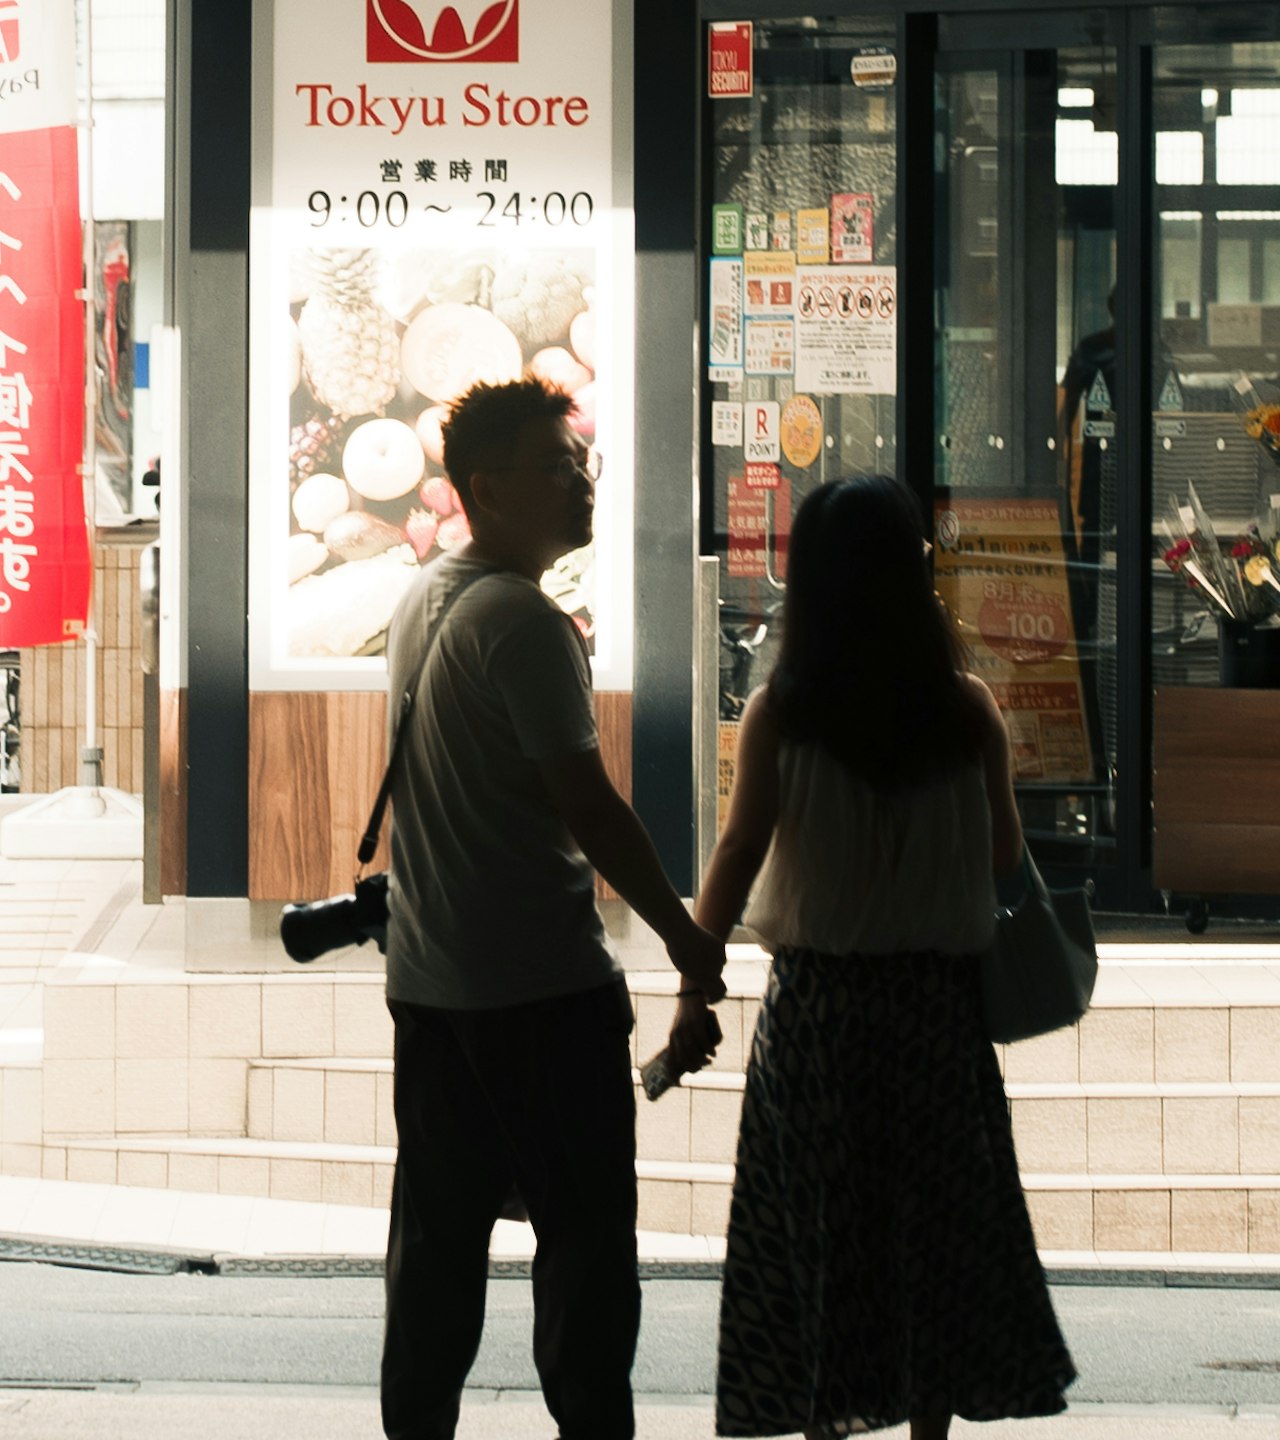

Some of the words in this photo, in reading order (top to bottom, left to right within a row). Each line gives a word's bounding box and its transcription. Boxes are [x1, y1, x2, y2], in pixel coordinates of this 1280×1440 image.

[711, 71, 749, 91] SECURITY
[295, 83, 448, 136] Tokyu
[462, 83, 590, 127] Store
[379, 158, 508, 183] 営業時間
[307, 190, 409, 228] 9:00
[476, 191, 594, 227] 24:00
[756, 408, 768, 435] R
[749, 443, 776, 456] POINT
[1006, 613, 1055, 640] 100
